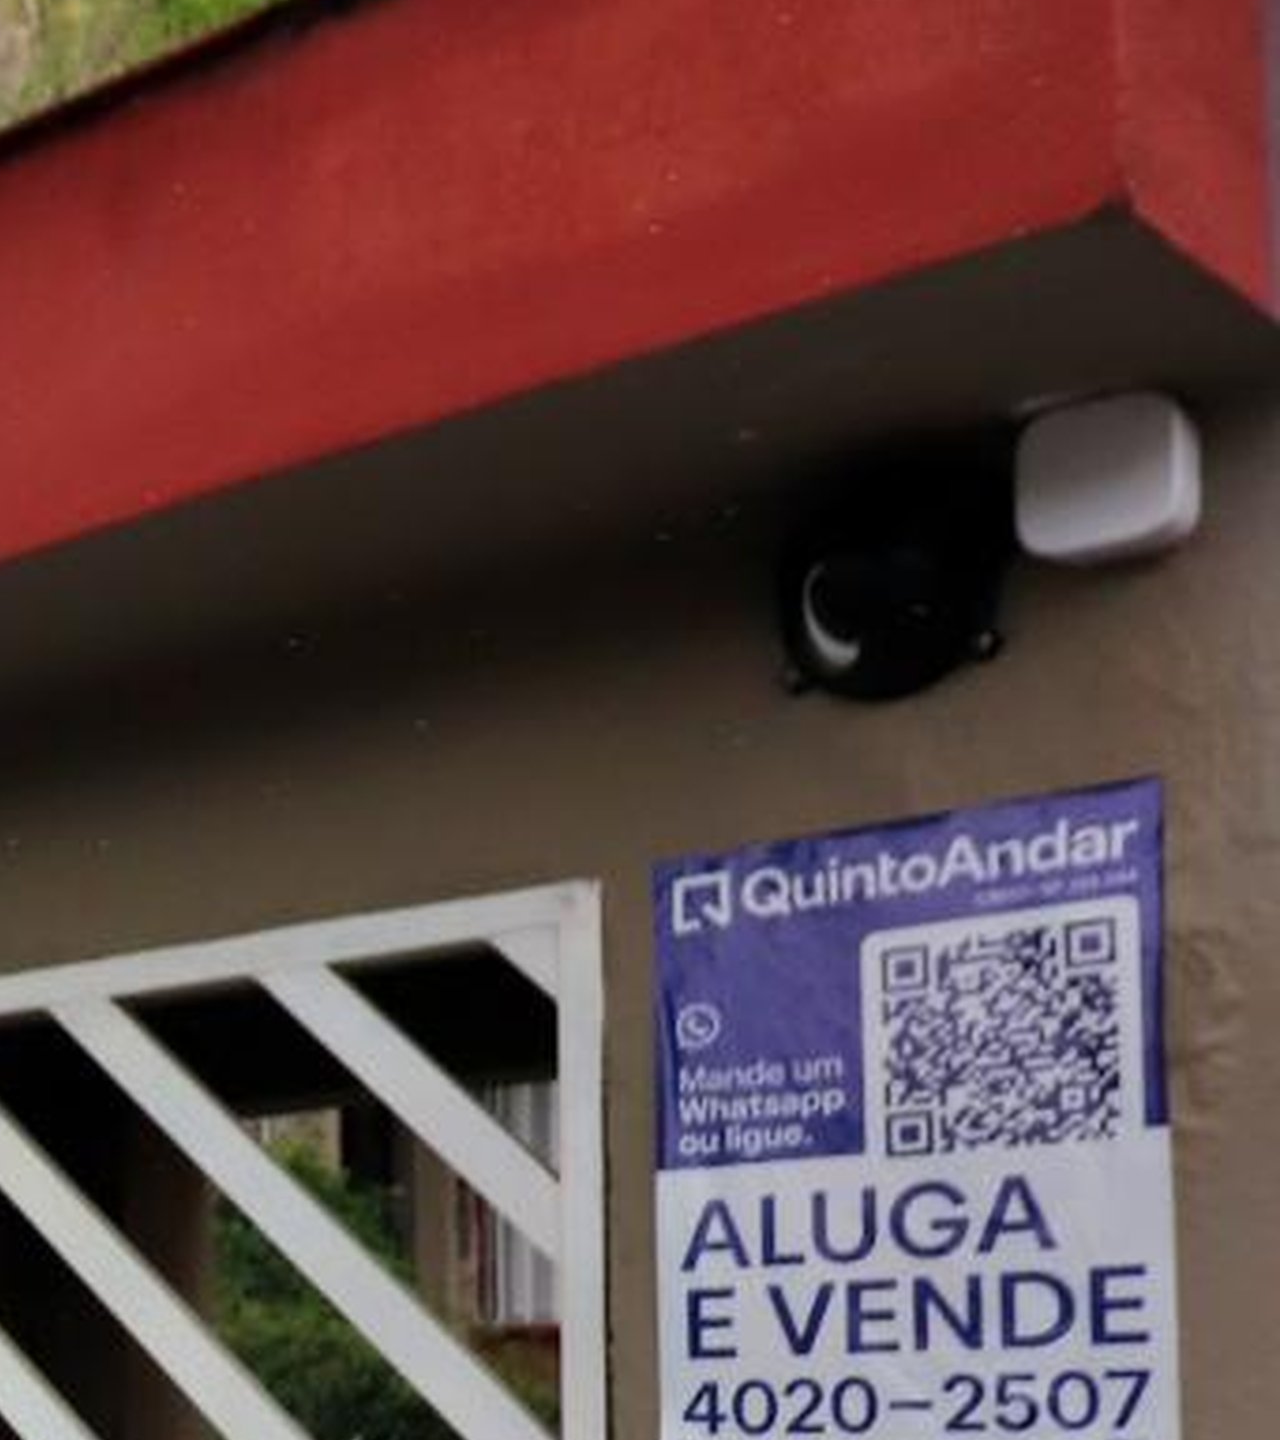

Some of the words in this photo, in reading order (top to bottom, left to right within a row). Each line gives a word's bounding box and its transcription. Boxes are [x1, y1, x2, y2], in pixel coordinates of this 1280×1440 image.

[741, 818, 1138, 918] QuintoAndar
[679, 1059, 786, 1093] Mande
[793, 1058, 844, 1082] um
[679, 1133, 720, 1155] ou
[681, 1175, 1057, 1271] ALUGA
[686, 1288, 737, 1360] E
[768, 1266, 1149, 1356] VENDE
